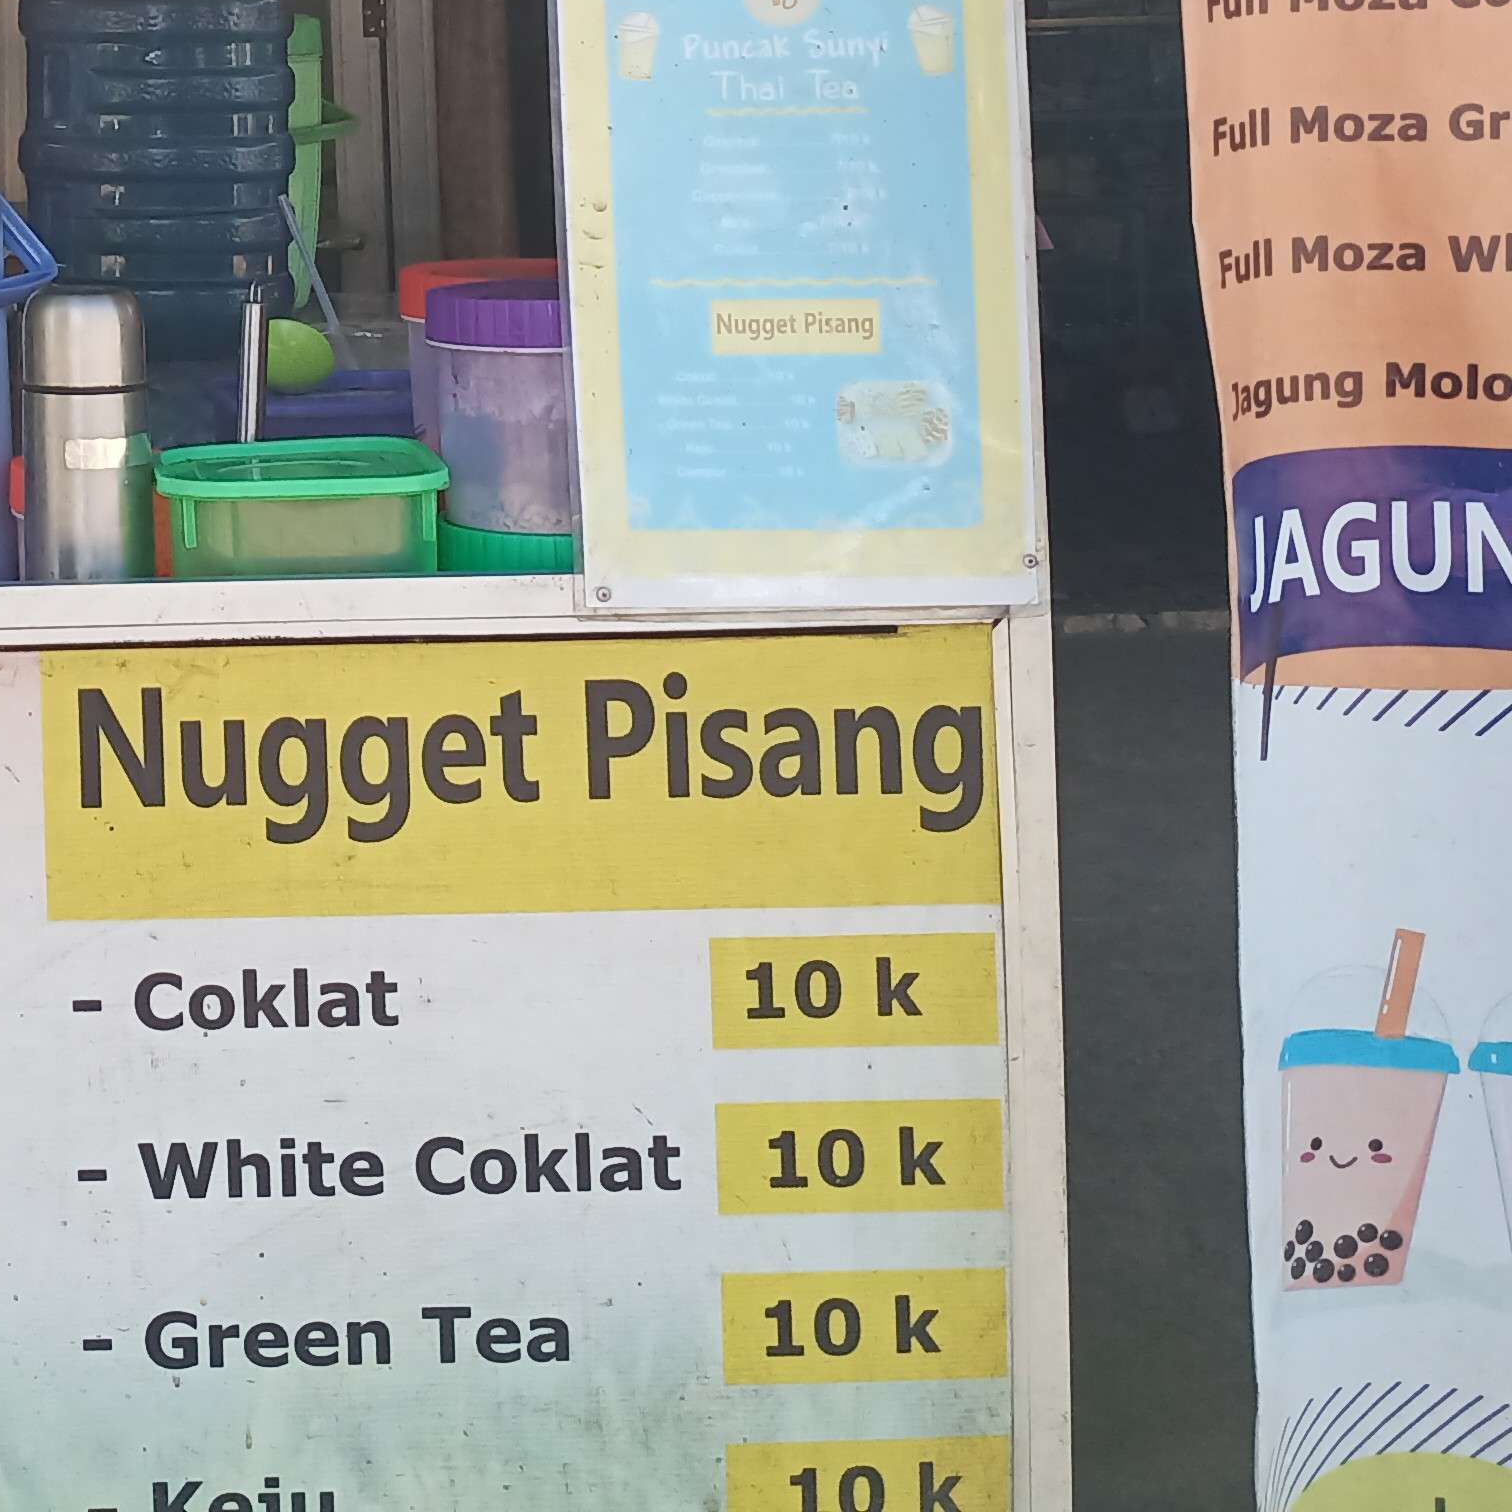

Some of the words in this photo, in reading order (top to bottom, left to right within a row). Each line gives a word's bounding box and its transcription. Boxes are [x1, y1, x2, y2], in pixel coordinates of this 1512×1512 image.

[682, 33, 791, 61] Puncak
[710, 71, 785, 101] Thai
[804, 68, 861, 100] Tea
[1212, 107, 1270, 157] Full
[1289, 105, 1427, 143] Moza
[1449, 103, 1511, 141] Gr
[1219, 238, 1273, 289] Full
[1291, 235, 1426, 272] Moza
[1448, 233, 1512, 273] W
[716, 313, 797, 340] Nugget
[804, 311, 874, 340] Pisang
[1232, 371, 1364, 422] Jagung
[1386, 362, 1512, 402] Molo
[1250, 500, 1512, 613] JAGUN
[77, 687, 540, 844] Nugget
[583, 672, 983, 832] Pisang
[133, 969, 399, 1030] Coklat
[745, 960, 842, 1020] 10
[877, 957, 921, 1017] k
[138, 1138, 385, 1200] White
[414, 1133, 682, 1195] Coklat
[767, 1129, 865, 1189] 10
[900, 1126, 945, 1187] k
[144, 1310, 391, 1370] Green
[422, 1305, 571, 1364] Tea
[763, 1298, 861, 1358] 10
[895, 1295, 940, 1354] k
[789, 1465, 885, 1510] 10
[918, 1462, 963, 1512] k
